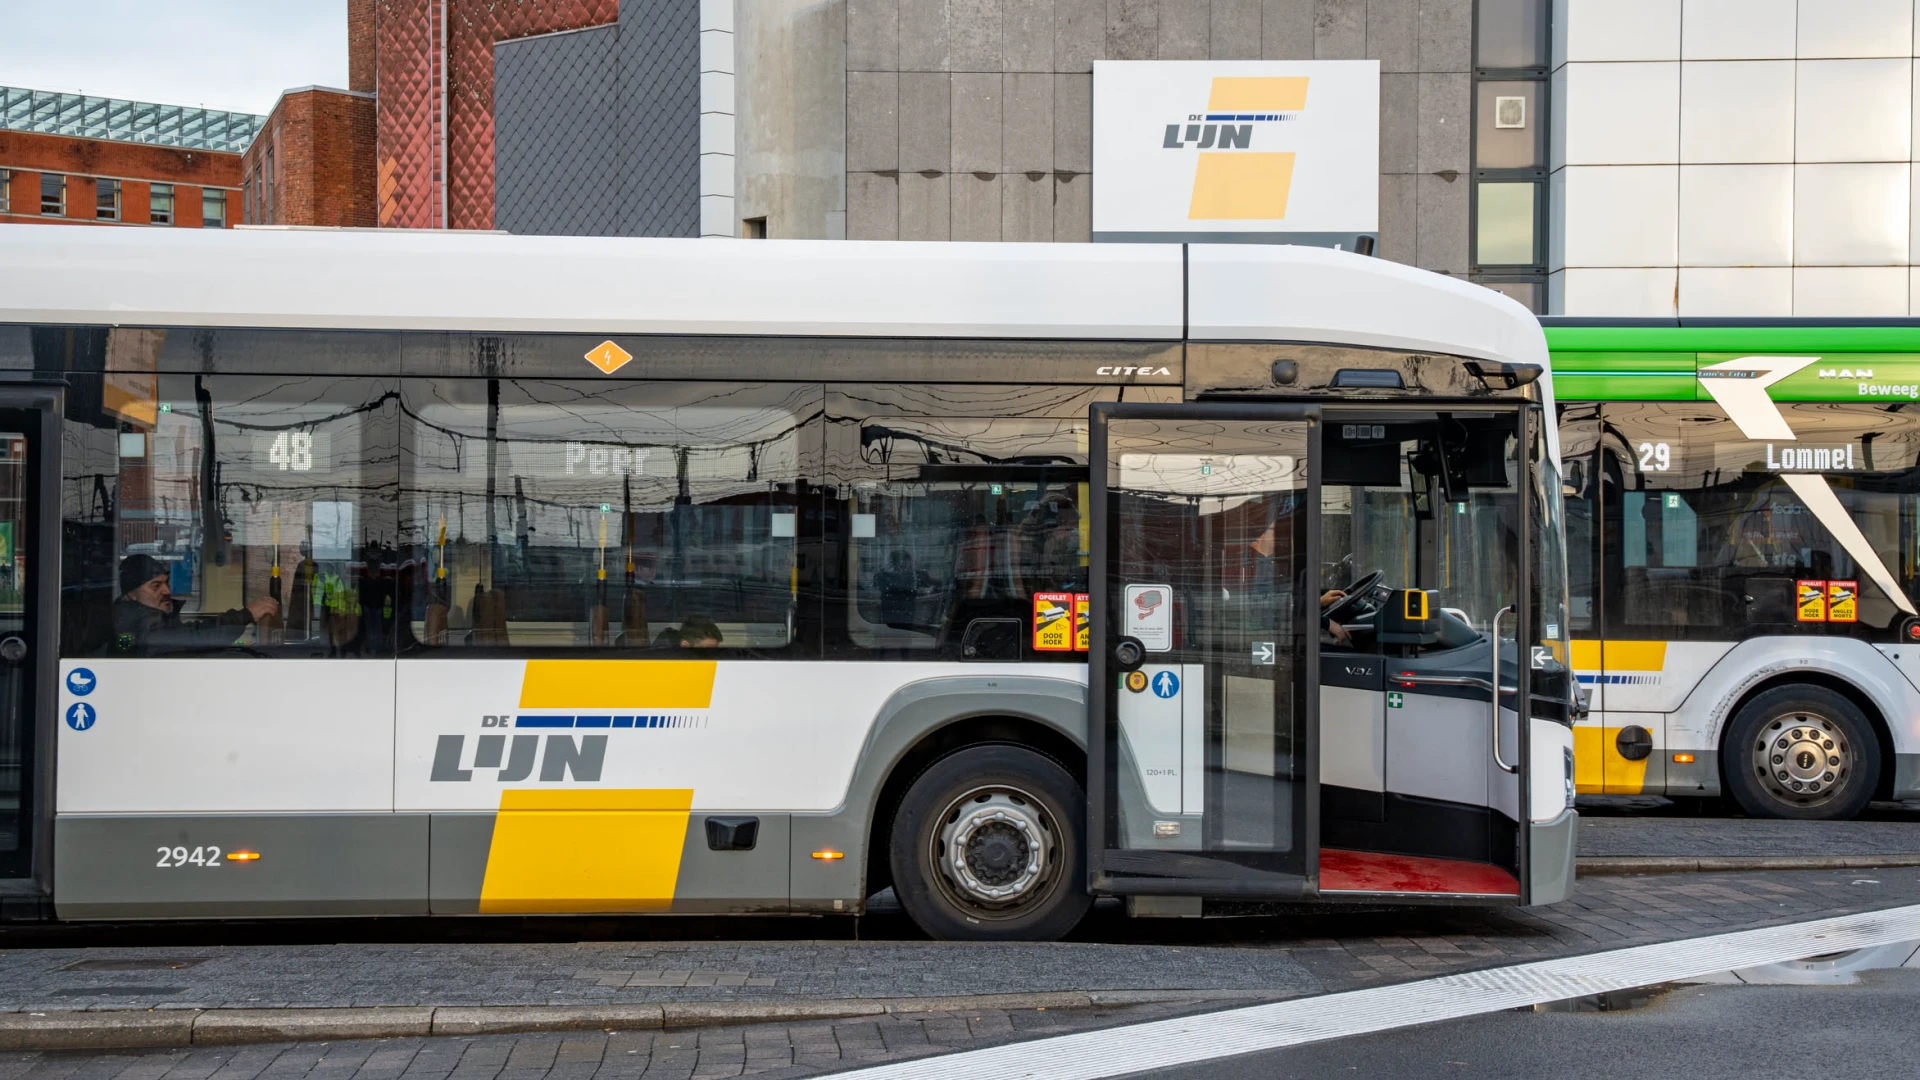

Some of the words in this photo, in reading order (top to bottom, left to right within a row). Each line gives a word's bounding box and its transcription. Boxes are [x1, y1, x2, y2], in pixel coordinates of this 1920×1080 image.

[1163, 124, 1253, 149] LIJN
[1096, 366, 1171, 376] CITEA
[1818, 368, 1873, 379] MAN
[1858, 382, 1919, 399] Beweeg
[270, 432, 312, 471] 48
[566, 441, 650, 475] Peer
[1639, 442, 1670, 471] 29
[1767, 443, 1854, 470] Lommel
[1345, 666, 1374, 676] VDL
[481, 715, 510, 728] DE
[430, 735, 608, 782] LIJN
[156, 846, 221, 868] 2942
